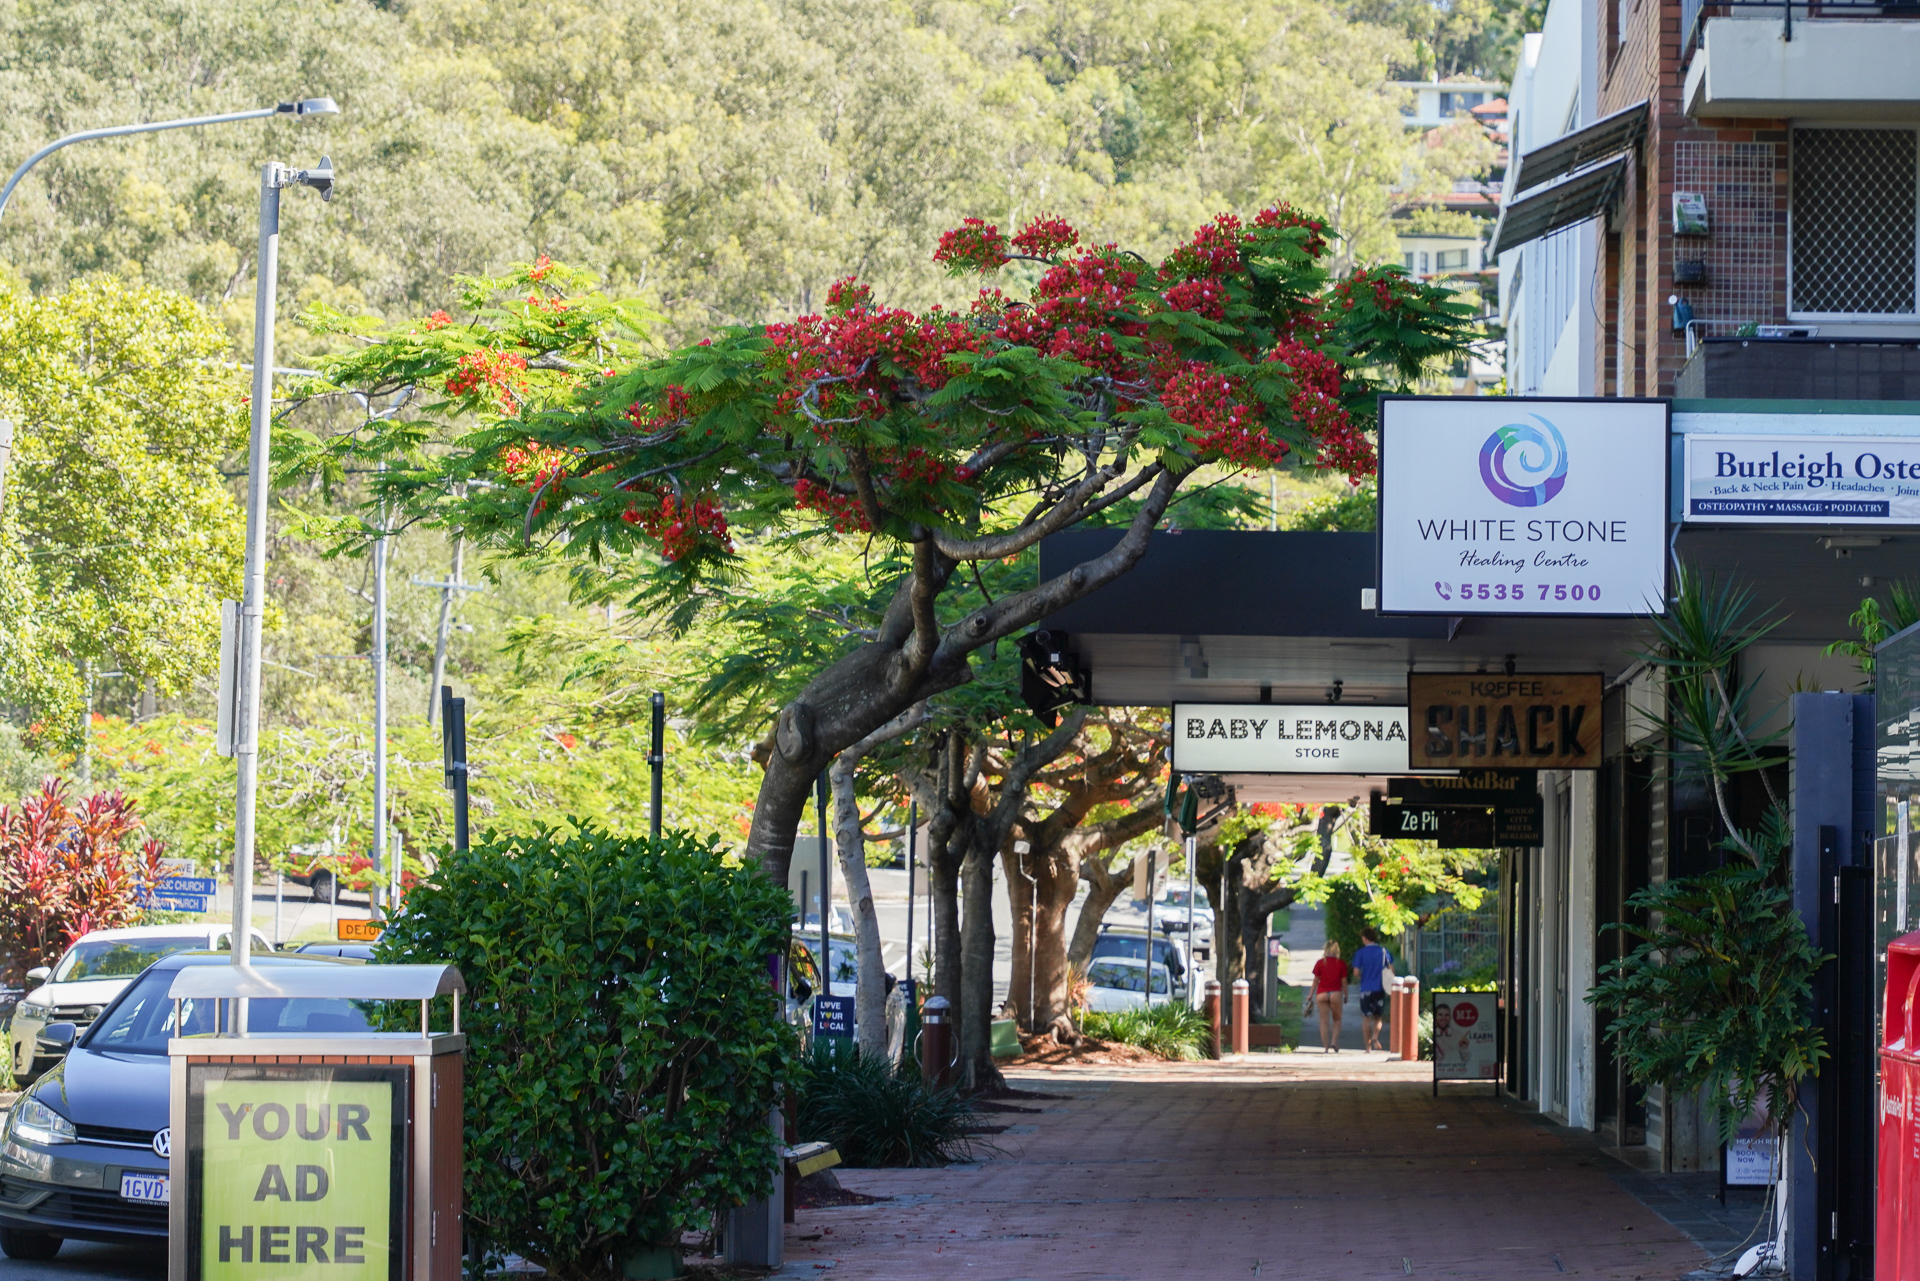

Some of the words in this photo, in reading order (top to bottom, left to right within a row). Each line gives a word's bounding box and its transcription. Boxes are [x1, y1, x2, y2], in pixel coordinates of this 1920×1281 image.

[1715, 451, 1844, 488] Burleigh
[1714, 485, 1738, 495] Back
[1741, 484, 1750, 492] &
[1753, 482, 1780, 492] Neck
[1782, 481, 1804, 491] Pain
[1831, 481, 1885, 492] Headaches
[1698, 502, 1768, 511] OSTEOPATHY
[1776, 503, 1823, 512] MASSAGE
[1831, 503, 1884, 513] PODIATRY
[1418, 519, 1516, 541] WHITE
[1527, 520, 1627, 542] STONE
[1459, 549, 1526, 573] Healing
[1533, 550, 1589, 567] Centre
[1460, 583, 1524, 600] 5535
[1538, 584, 1601, 601] 7500
[1471, 681, 1543, 698] KOFFEE
[1187, 718, 1269, 740] BABY
[1278, 719, 1407, 742] LEMONA
[1426, 705, 1586, 757] SHACK
[1295, 748, 1340, 758] STORE
[1401, 810, 1418, 831] Ze
[175, 880, 204, 891] CHURCH
[346, 924, 380, 935] DETO
[217, 1103, 372, 1141] YOUR
[254, 1165, 328, 1202] AD
[219, 1226, 366, 1263] HERE
